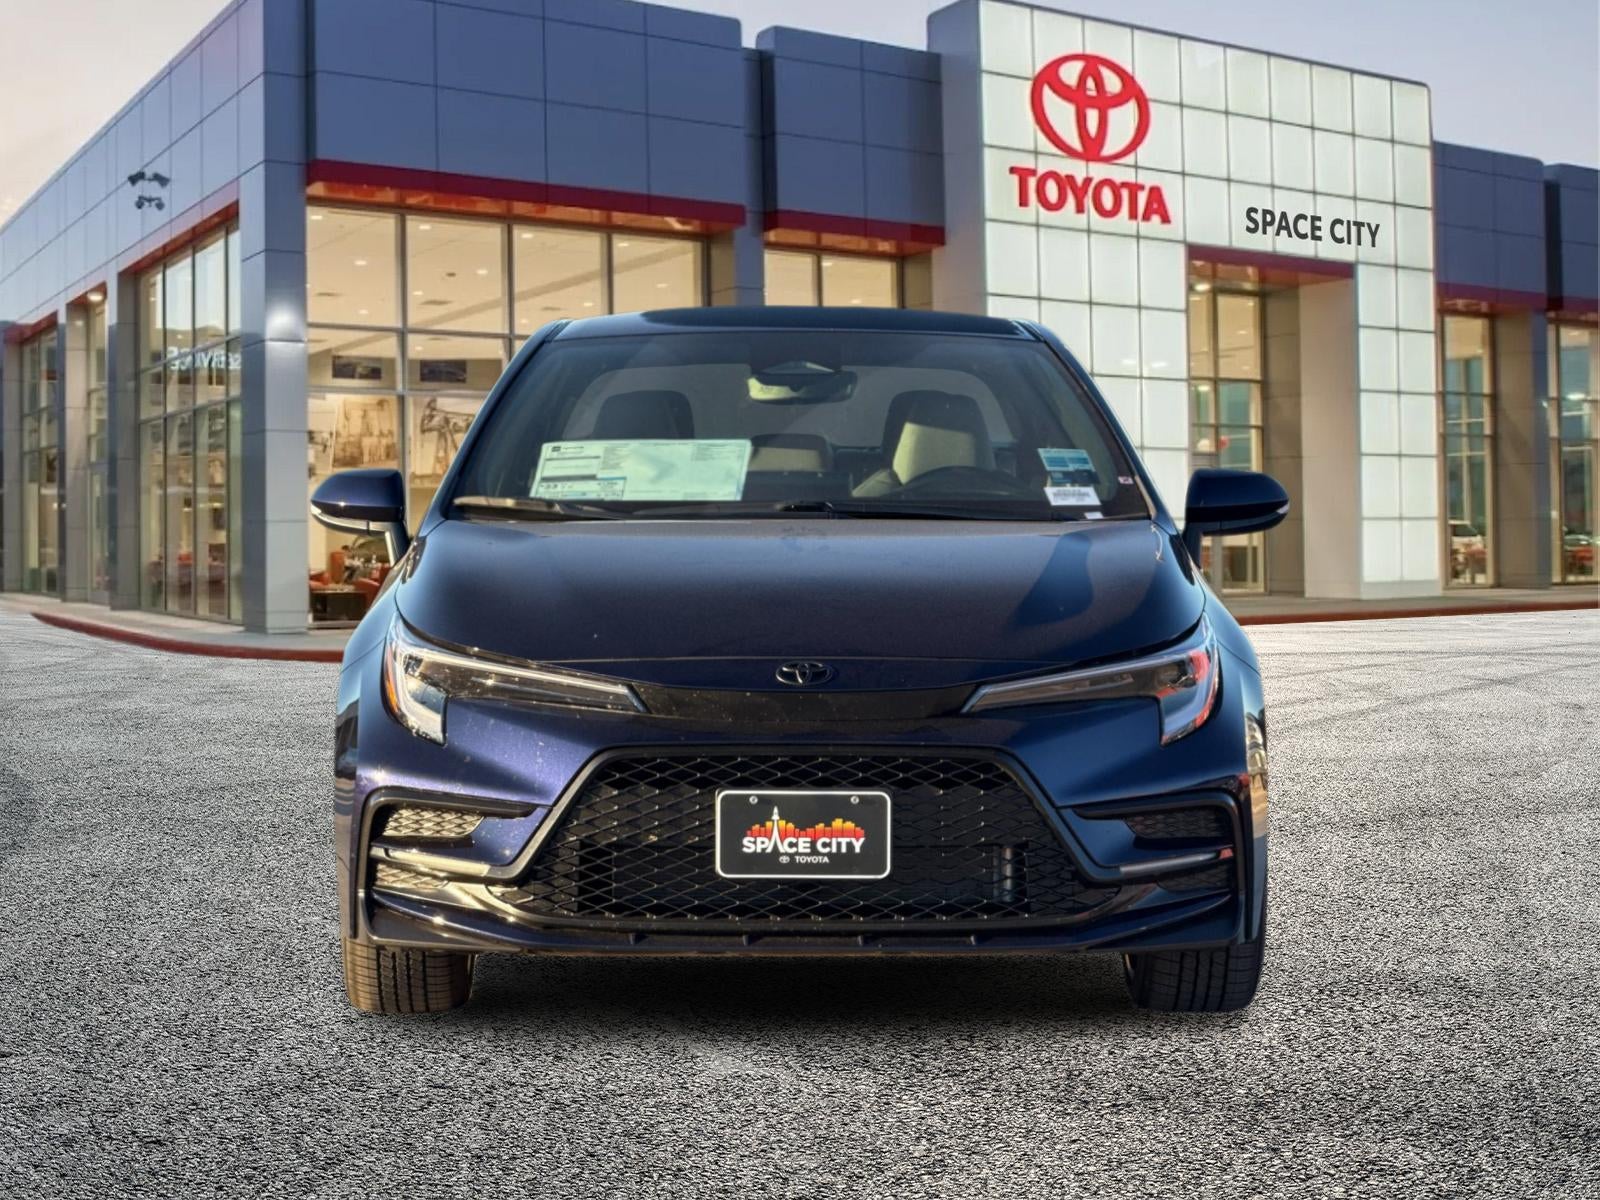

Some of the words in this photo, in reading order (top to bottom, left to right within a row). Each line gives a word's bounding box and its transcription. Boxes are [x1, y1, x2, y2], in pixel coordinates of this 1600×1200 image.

[1009, 166, 1171, 225] TOYOTA
[1245, 206, 1323, 242] SPACE
[1329, 217, 1381, 248] CITY
[742, 836, 811, 854] SPACE
[816, 836, 866, 854] CITY
[794, 855, 830, 864] TOYOTA
